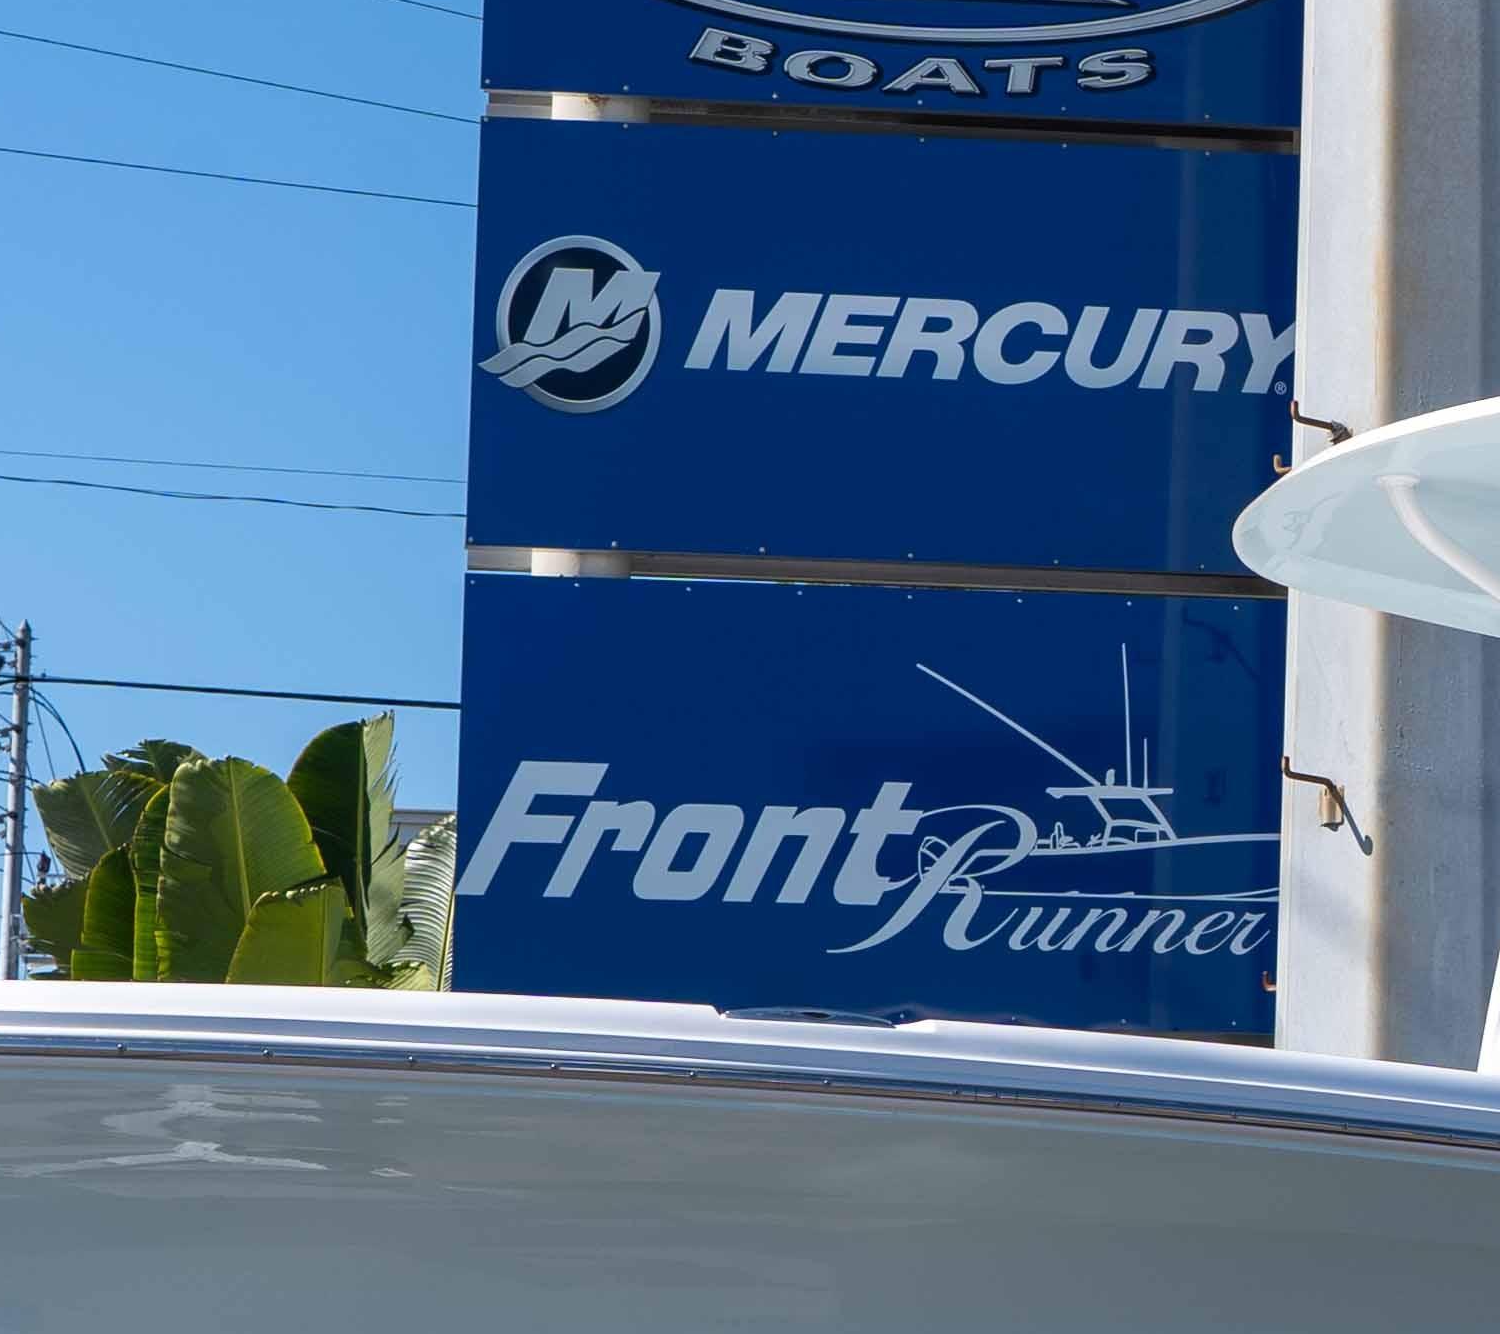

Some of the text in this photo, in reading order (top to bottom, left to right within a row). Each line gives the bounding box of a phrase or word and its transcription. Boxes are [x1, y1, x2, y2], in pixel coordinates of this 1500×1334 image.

[688, 27, 1154, 95] BOATS
[683, 288, 1297, 395] MERCURY
[454, 760, 1270, 955] Front Runner
